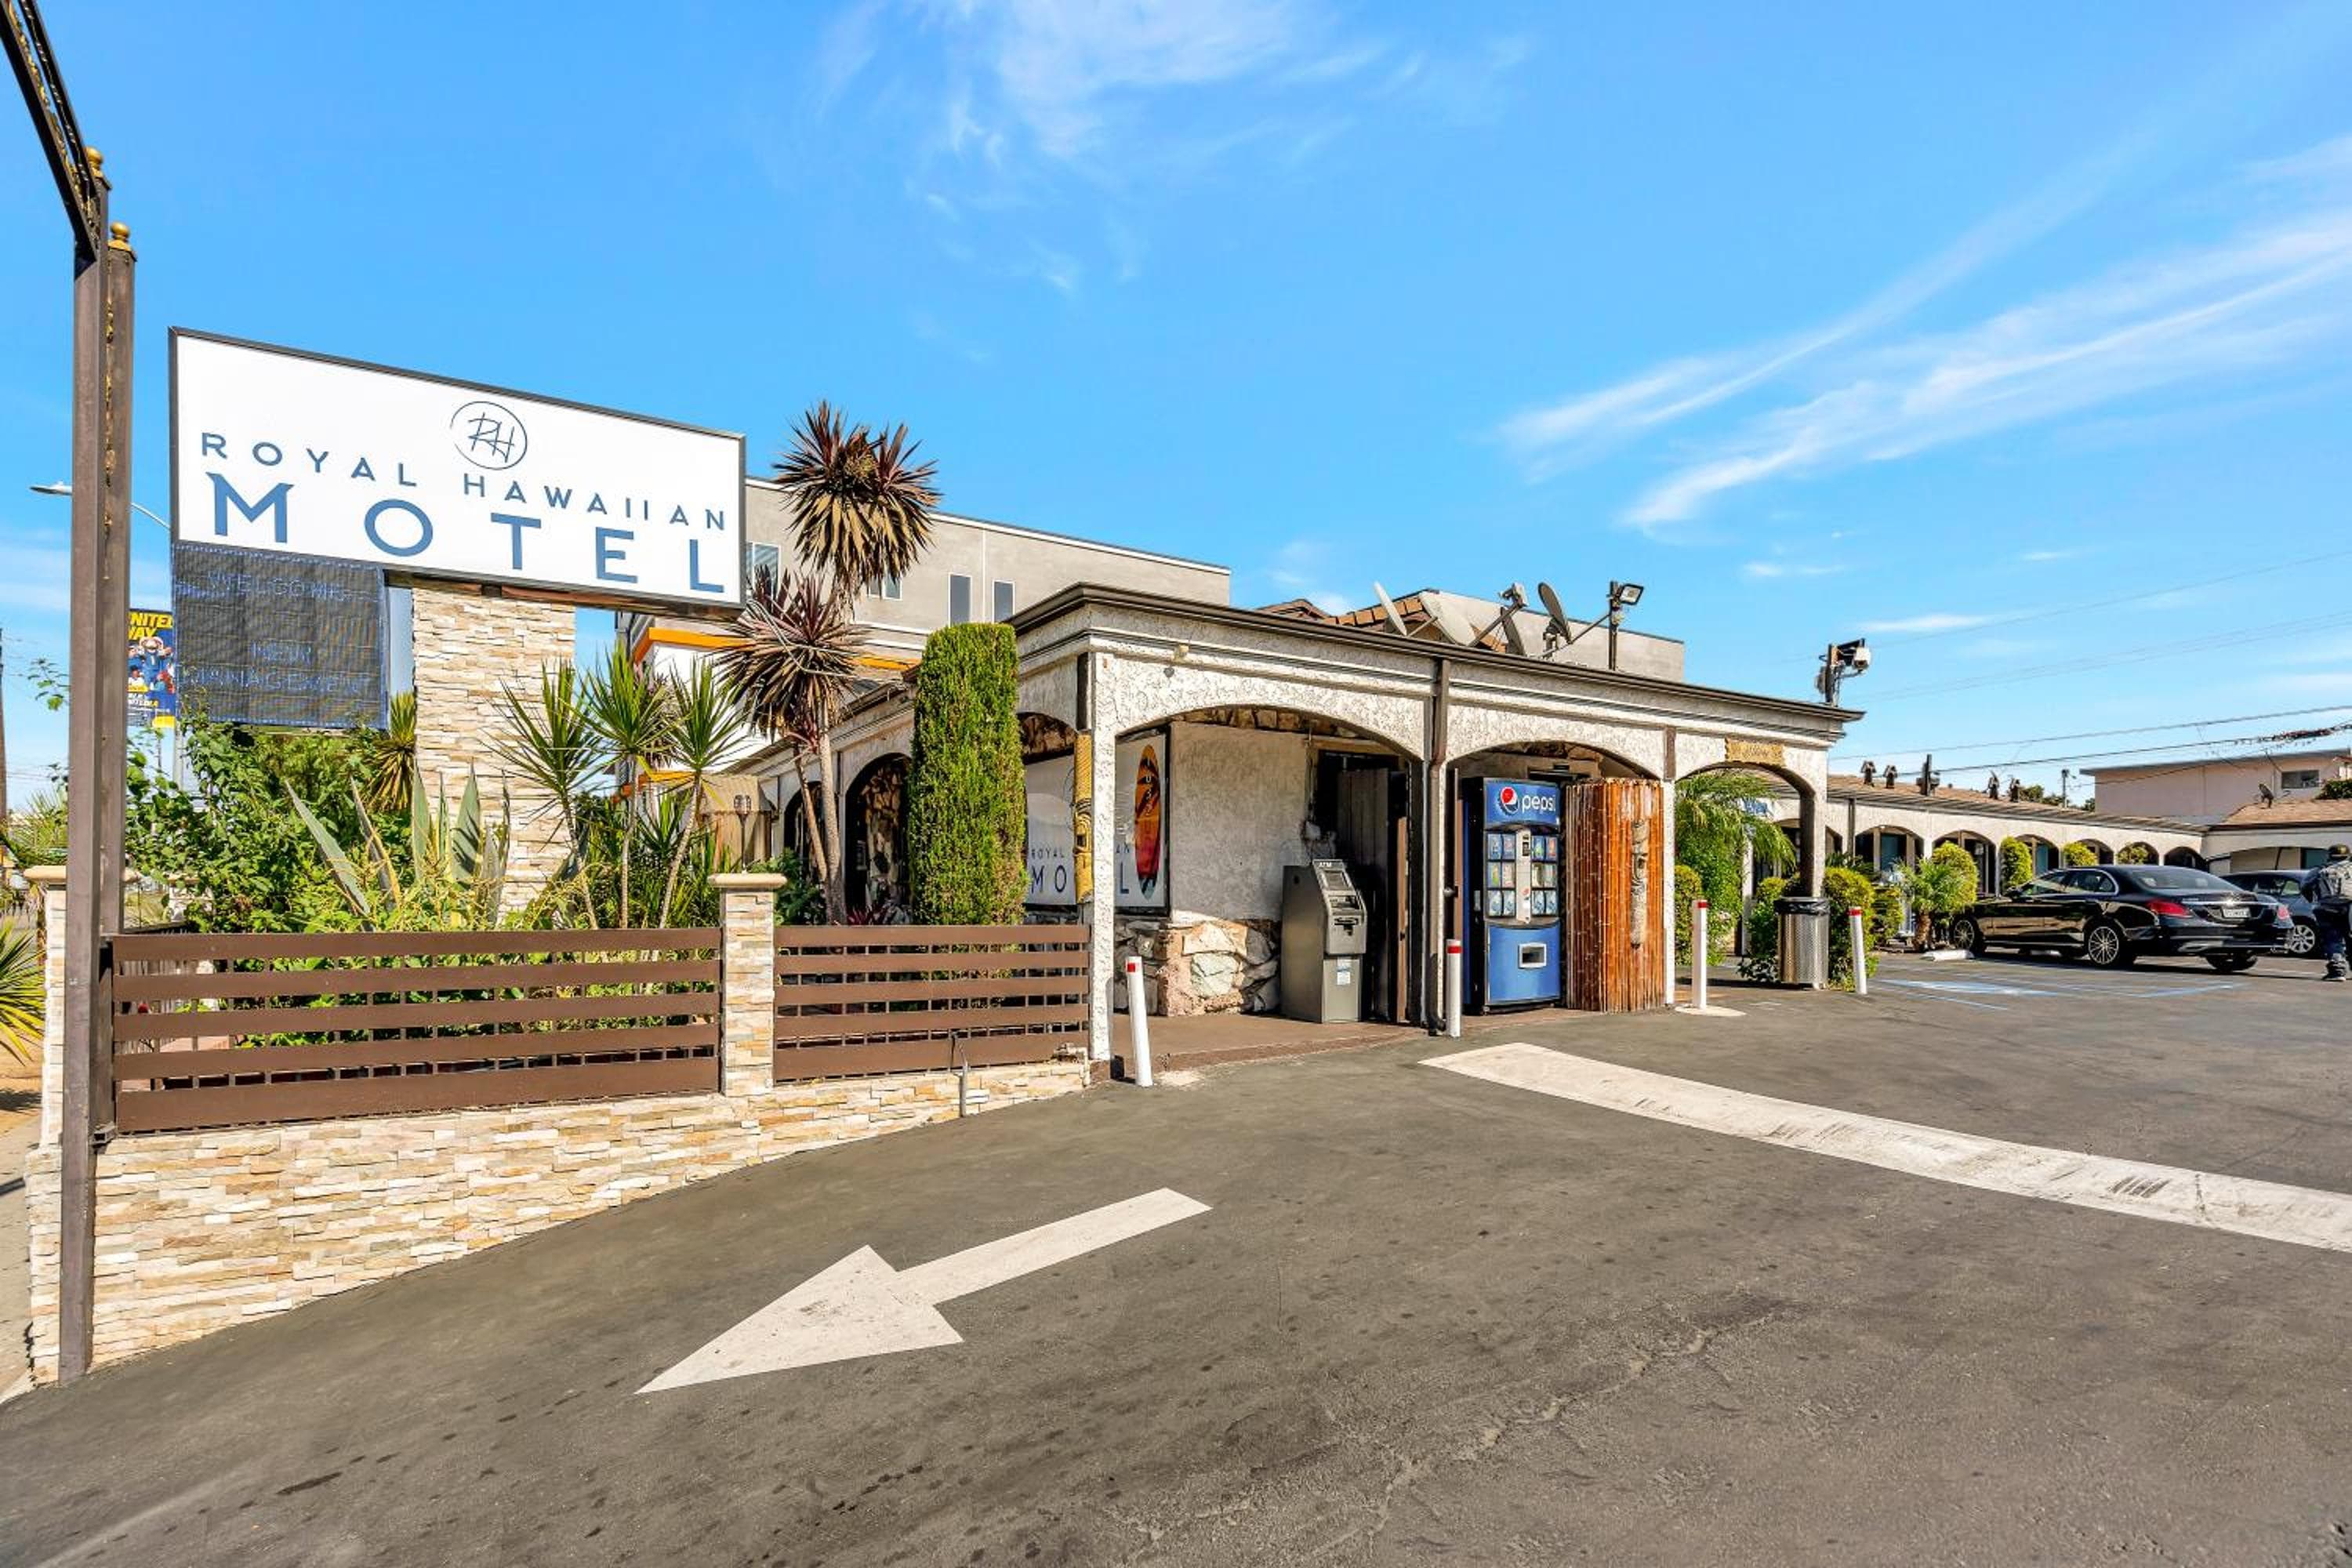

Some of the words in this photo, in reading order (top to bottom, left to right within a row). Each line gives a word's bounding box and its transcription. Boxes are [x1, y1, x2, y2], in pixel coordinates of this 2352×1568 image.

[201, 432, 417, 487] ROYAL
[463, 473, 724, 531] HAWAIIAN
[205, 471, 724, 593] MOTEL
[1522, 794, 1556, 815] pepsi
